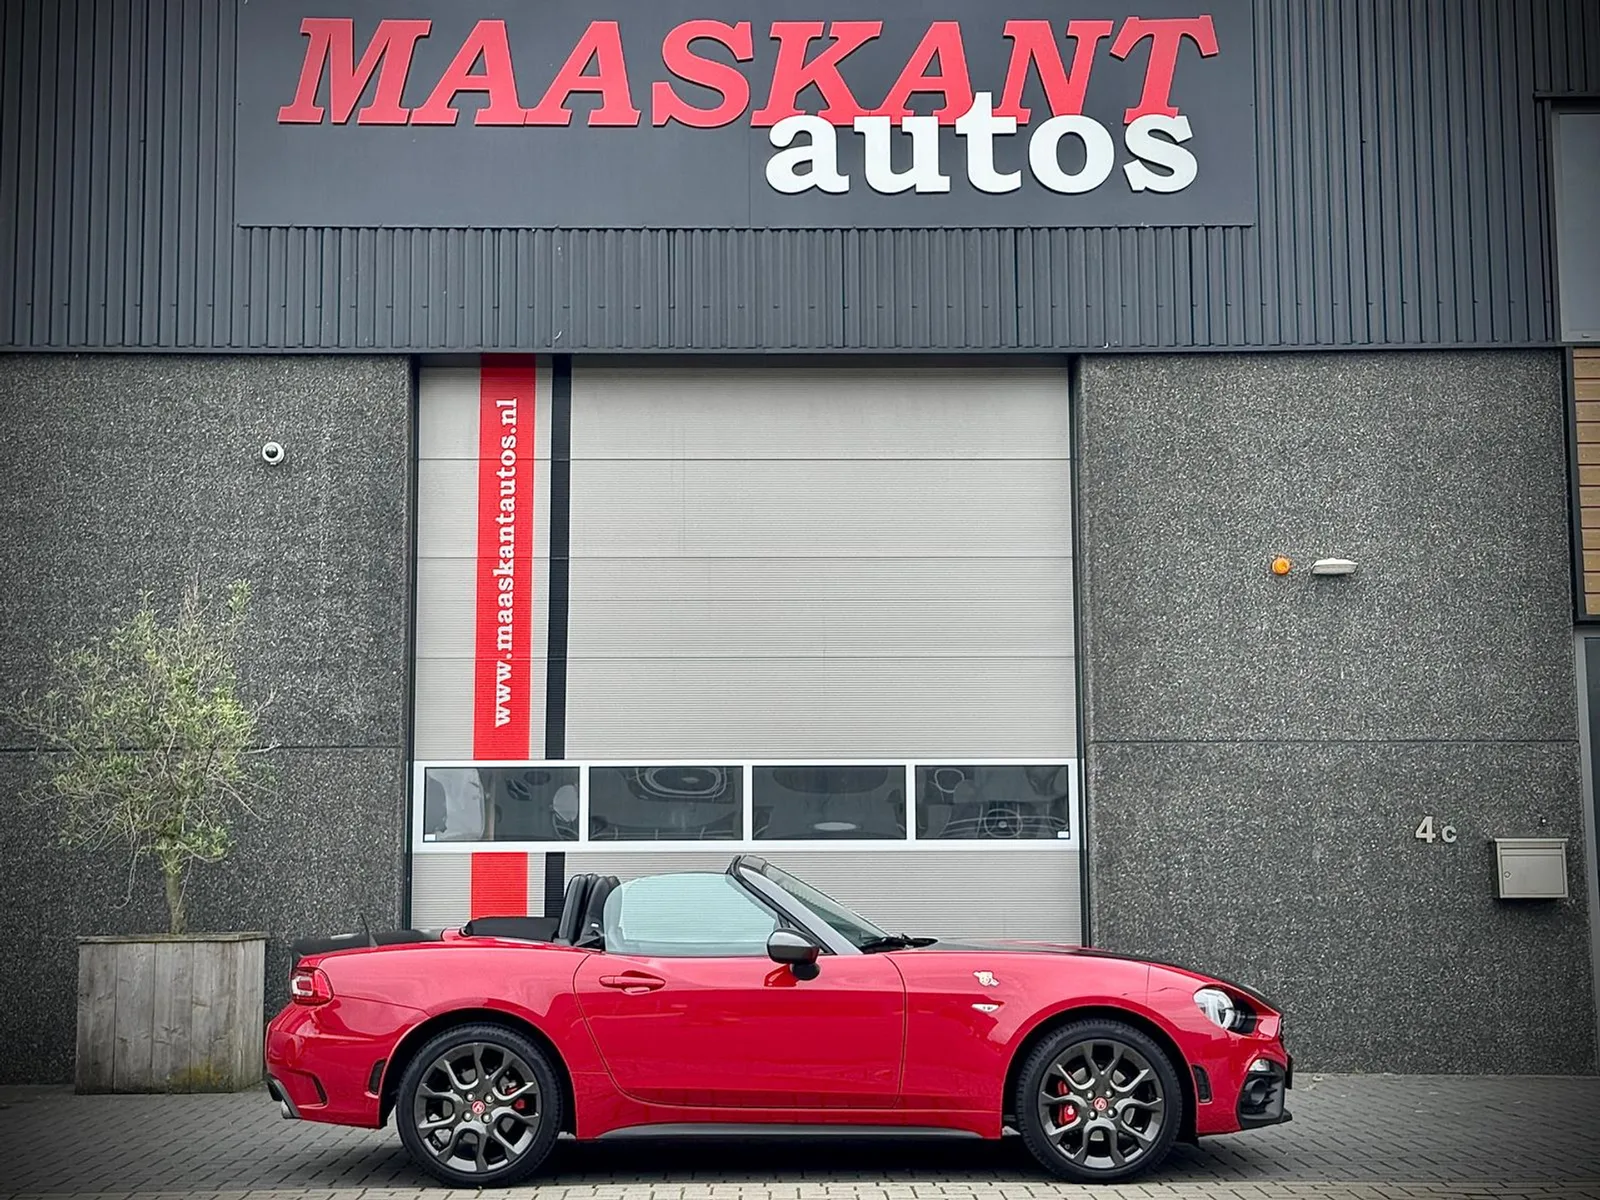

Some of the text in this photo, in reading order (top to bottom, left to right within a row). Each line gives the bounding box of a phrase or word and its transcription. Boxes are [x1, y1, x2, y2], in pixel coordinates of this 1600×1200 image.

[278, 15, 1219, 127] MAASKANT
[765, 91, 1198, 194] autos
[492, 397, 518, 728] www.maaskantautos.nl
